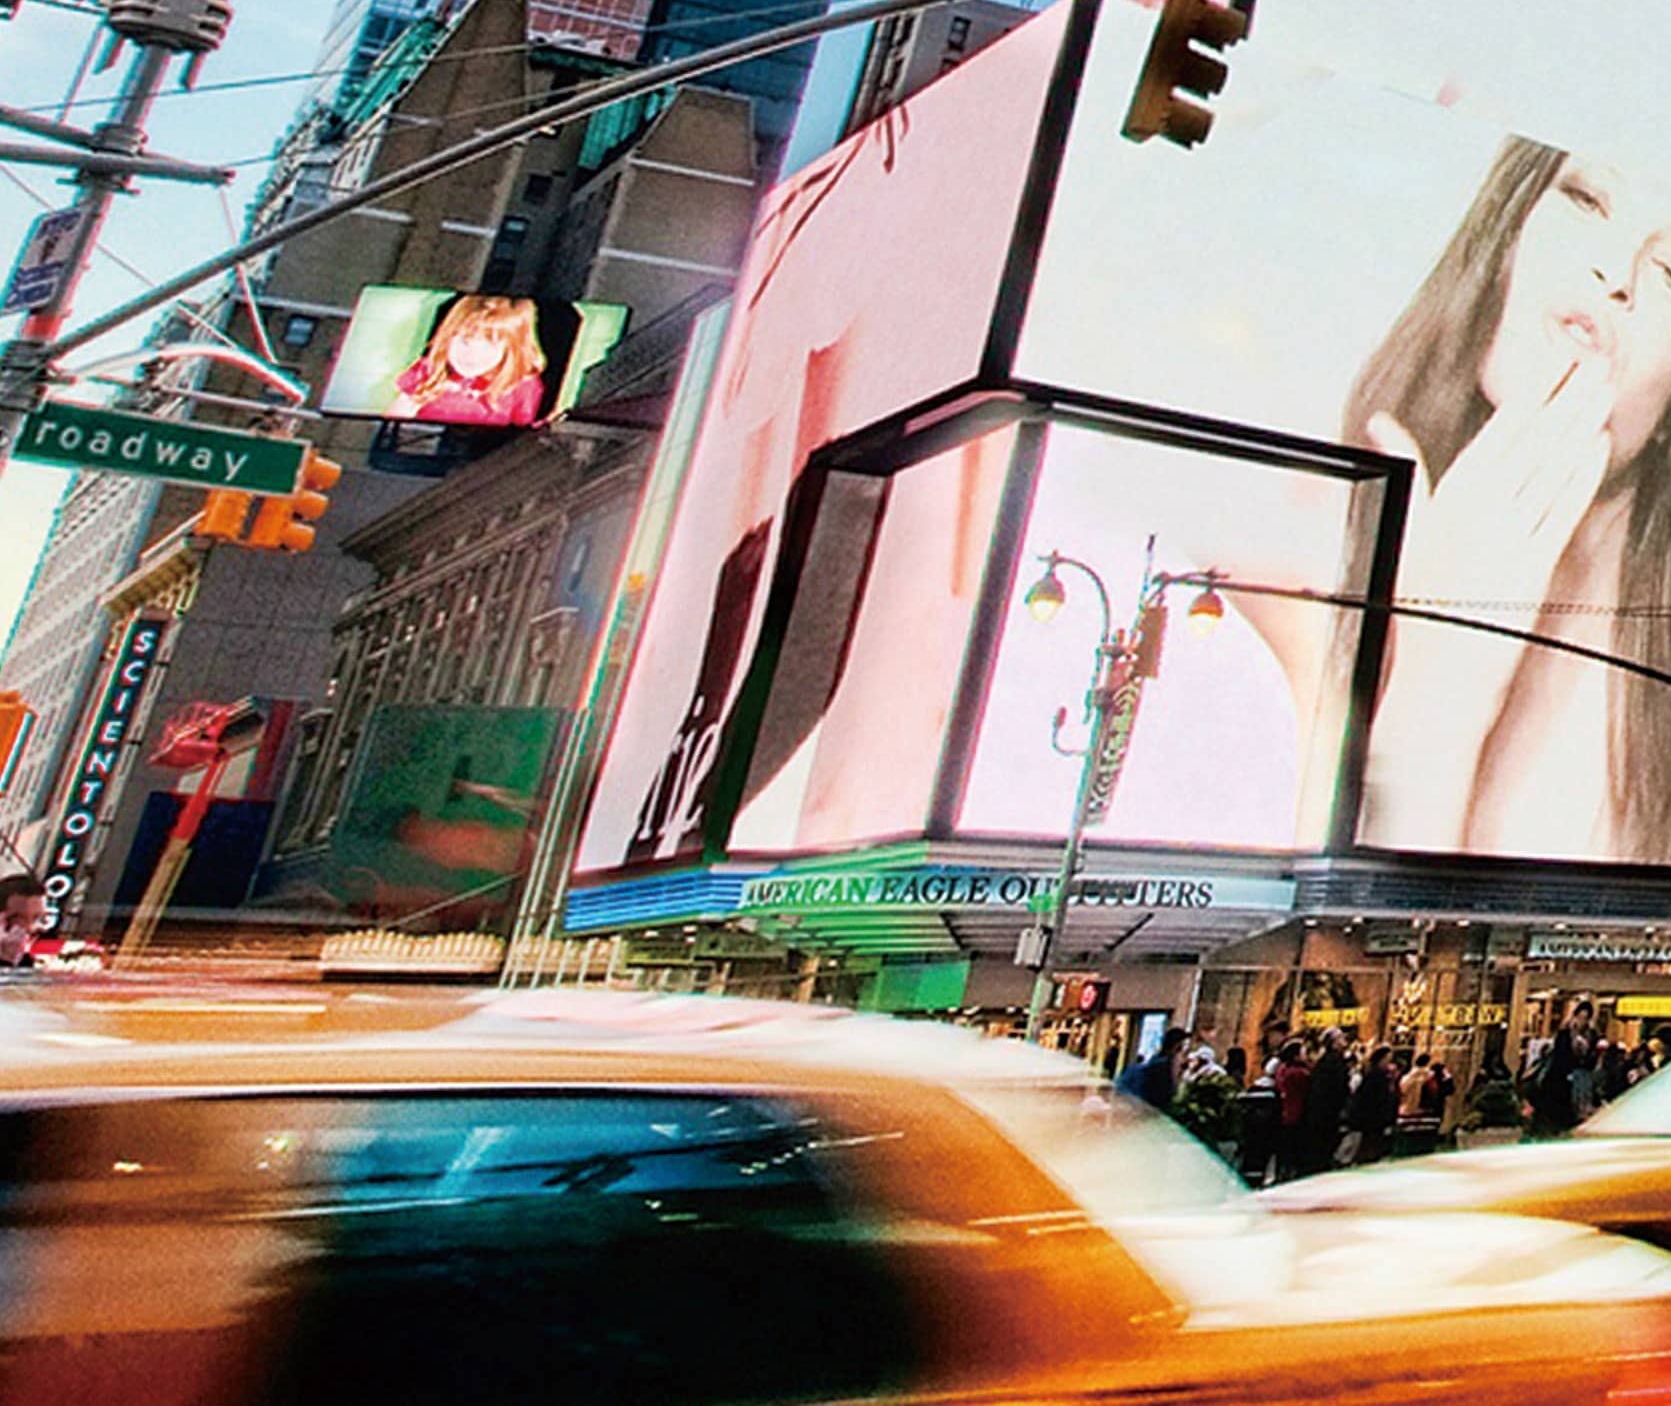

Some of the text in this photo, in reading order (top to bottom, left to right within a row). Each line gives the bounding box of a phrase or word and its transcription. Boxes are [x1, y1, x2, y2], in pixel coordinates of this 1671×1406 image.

[35, 420, 248, 481] roadway
[743, 876, 1214, 909] AMERICAN EAGLE OUTERS
